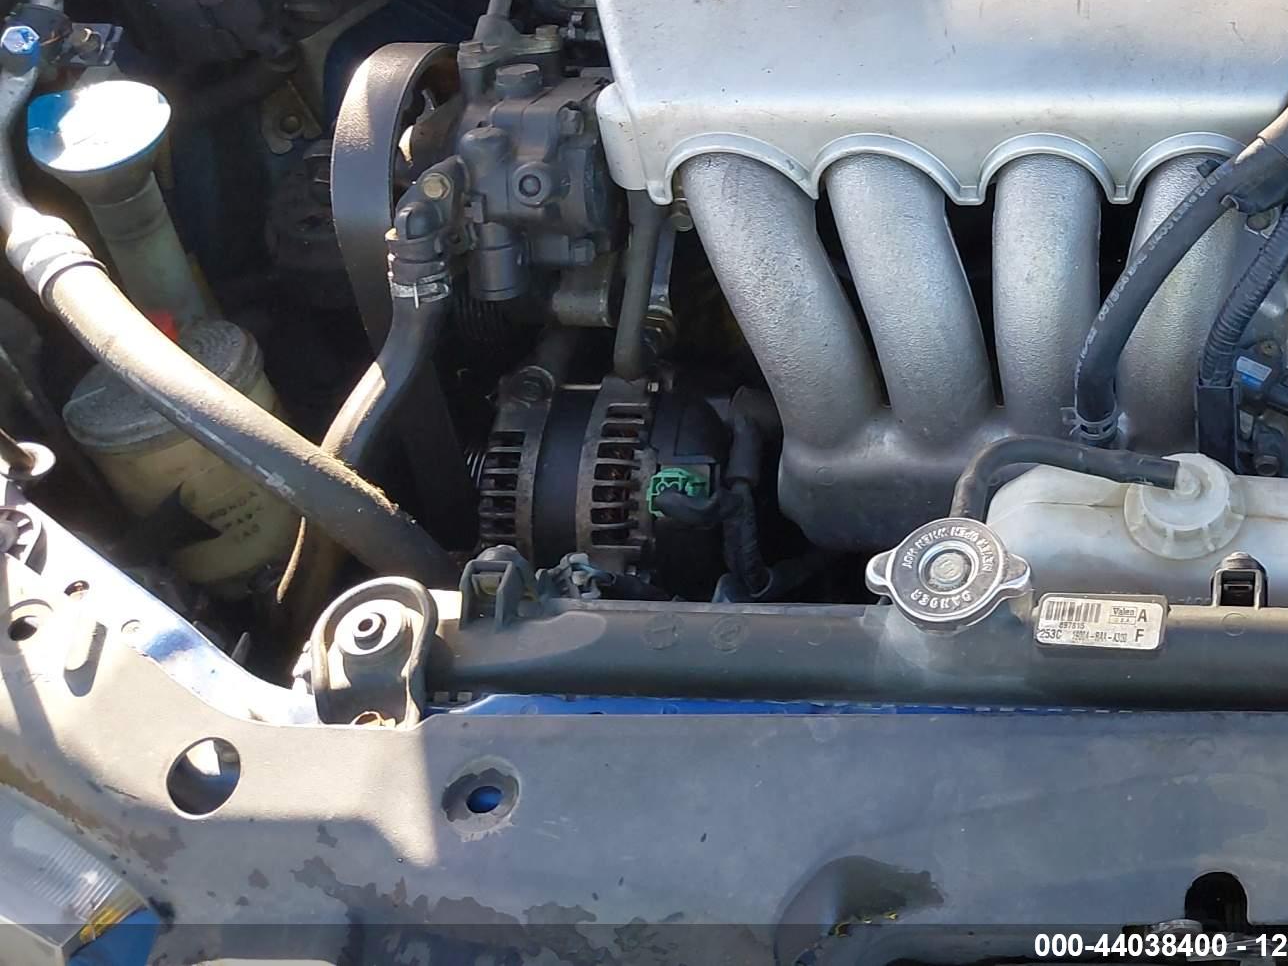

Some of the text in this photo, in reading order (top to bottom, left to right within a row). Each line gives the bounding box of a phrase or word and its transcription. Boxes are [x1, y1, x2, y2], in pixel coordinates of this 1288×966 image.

[910, 589, 973, 610] DANGER
[1137, 608, 1148, 623] A
[1134, 628, 1145, 643] F
